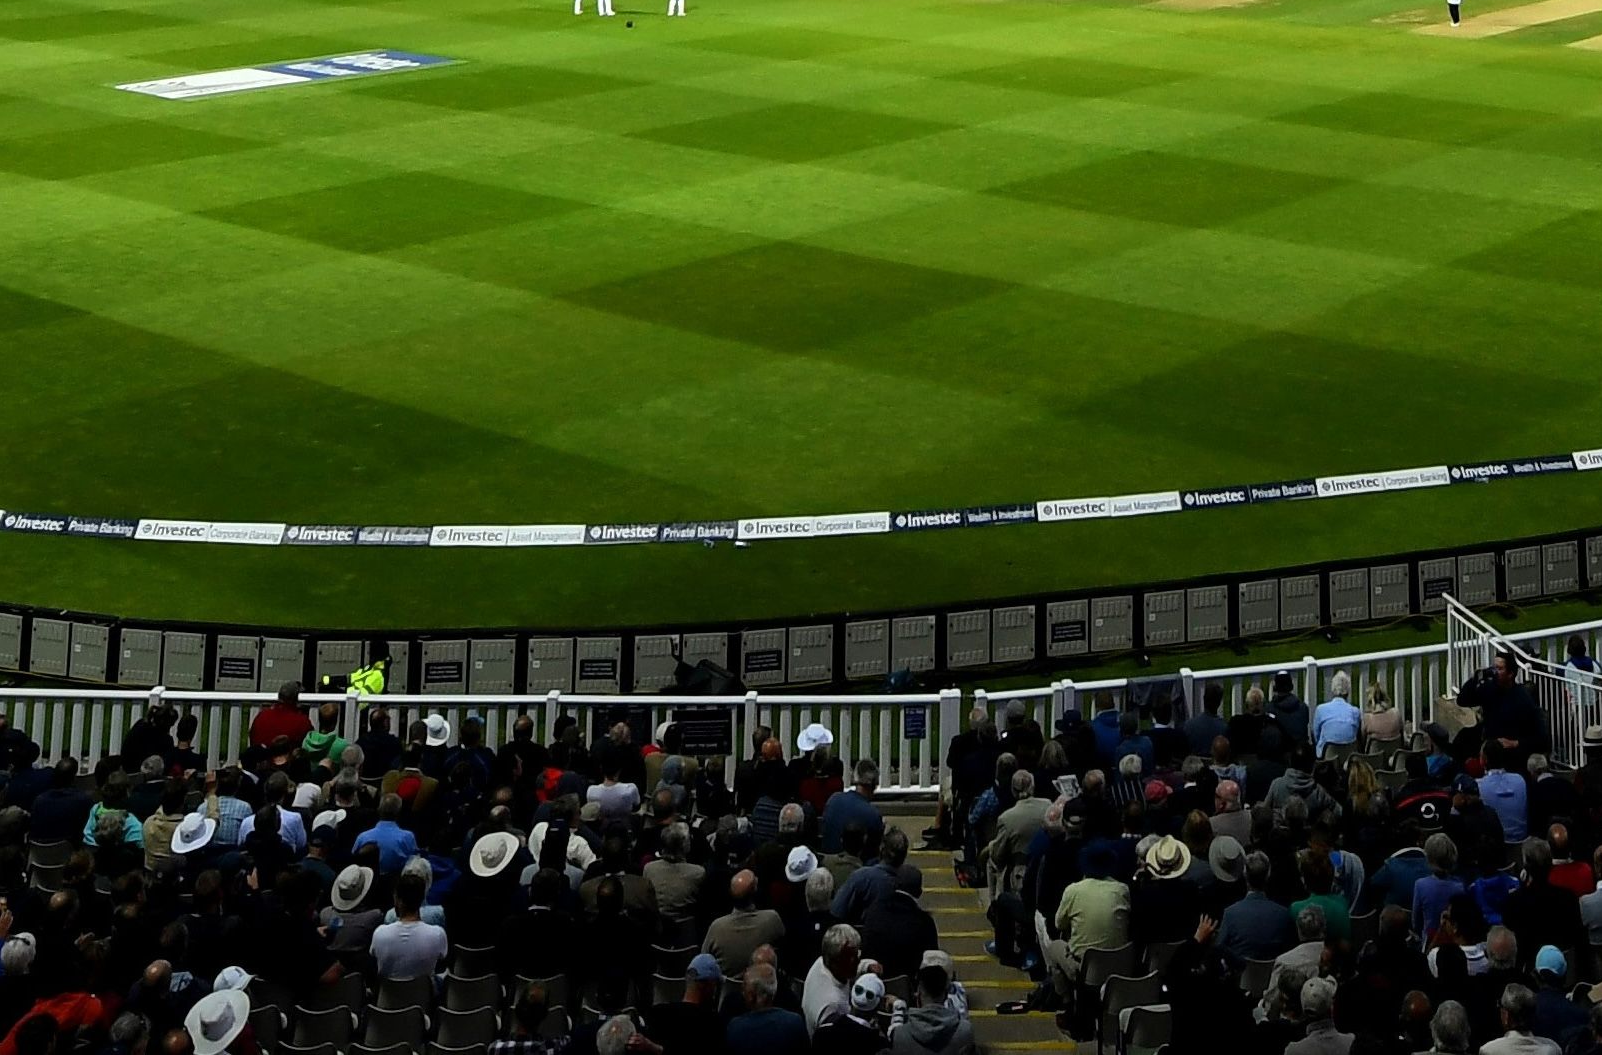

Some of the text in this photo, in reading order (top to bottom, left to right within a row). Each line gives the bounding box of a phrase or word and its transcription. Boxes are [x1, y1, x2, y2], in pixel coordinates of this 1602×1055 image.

[1462, 462, 1508, 479] Investec
[1331, 470, 1447, 491] Investec Corporate Banking
[1196, 483, 1316, 505] Investec Private Banking
[1054, 499, 1178, 516] Investec Asset Management
[16, 515, 65, 532] Investec
[99, 524, 133, 537] Banking
[756, 518, 887, 534] Investec Corporate Banking
[907, 512, 960, 527] Investec
[152, 524, 205, 538] Investec
[249, 530, 279, 542] Banking
[299, 526, 353, 542] Investec
[448, 529, 502, 542] Investec
[602, 525, 734, 540] Investec Private Banking
